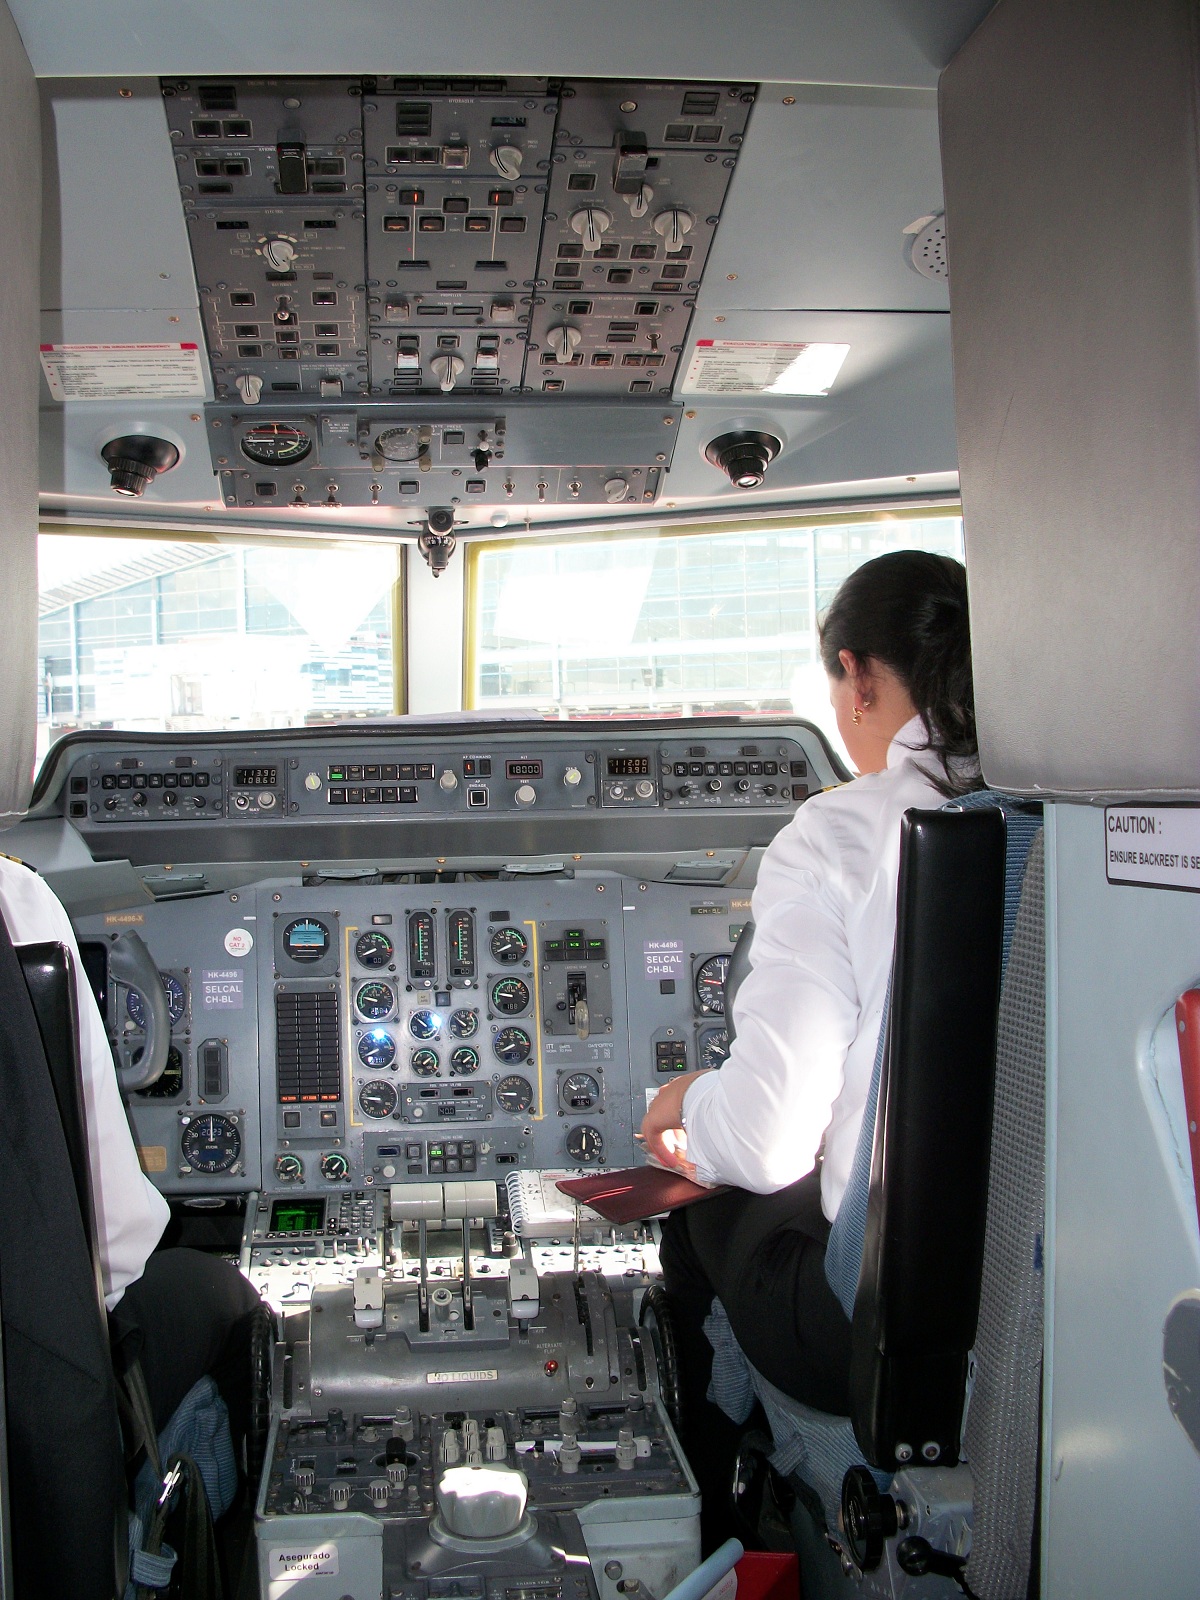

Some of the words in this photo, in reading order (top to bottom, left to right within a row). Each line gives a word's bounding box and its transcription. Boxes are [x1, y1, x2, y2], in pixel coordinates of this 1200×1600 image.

[512, 765, 540, 774] 18000
[1108, 815, 1155, 834] CAUTION
[1109, 850, 1137, 864] ENSURE
[1139, 852, 1179, 867] BACKREST
[1181, 855, 1189, 868] IS
[646, 954, 682, 964] SELCAL
[646, 965, 675, 974] CH-BL
[207, 971, 238, 979] HK-4496
[205, 985, 242, 994] SELCAL
[205, 995, 234, 1004] CH-BL
[452, 1370, 494, 1380] LIQUIDS
[279, 1551, 331, 1562] Asegurado
[284, 1562, 319, 1572] Locked
